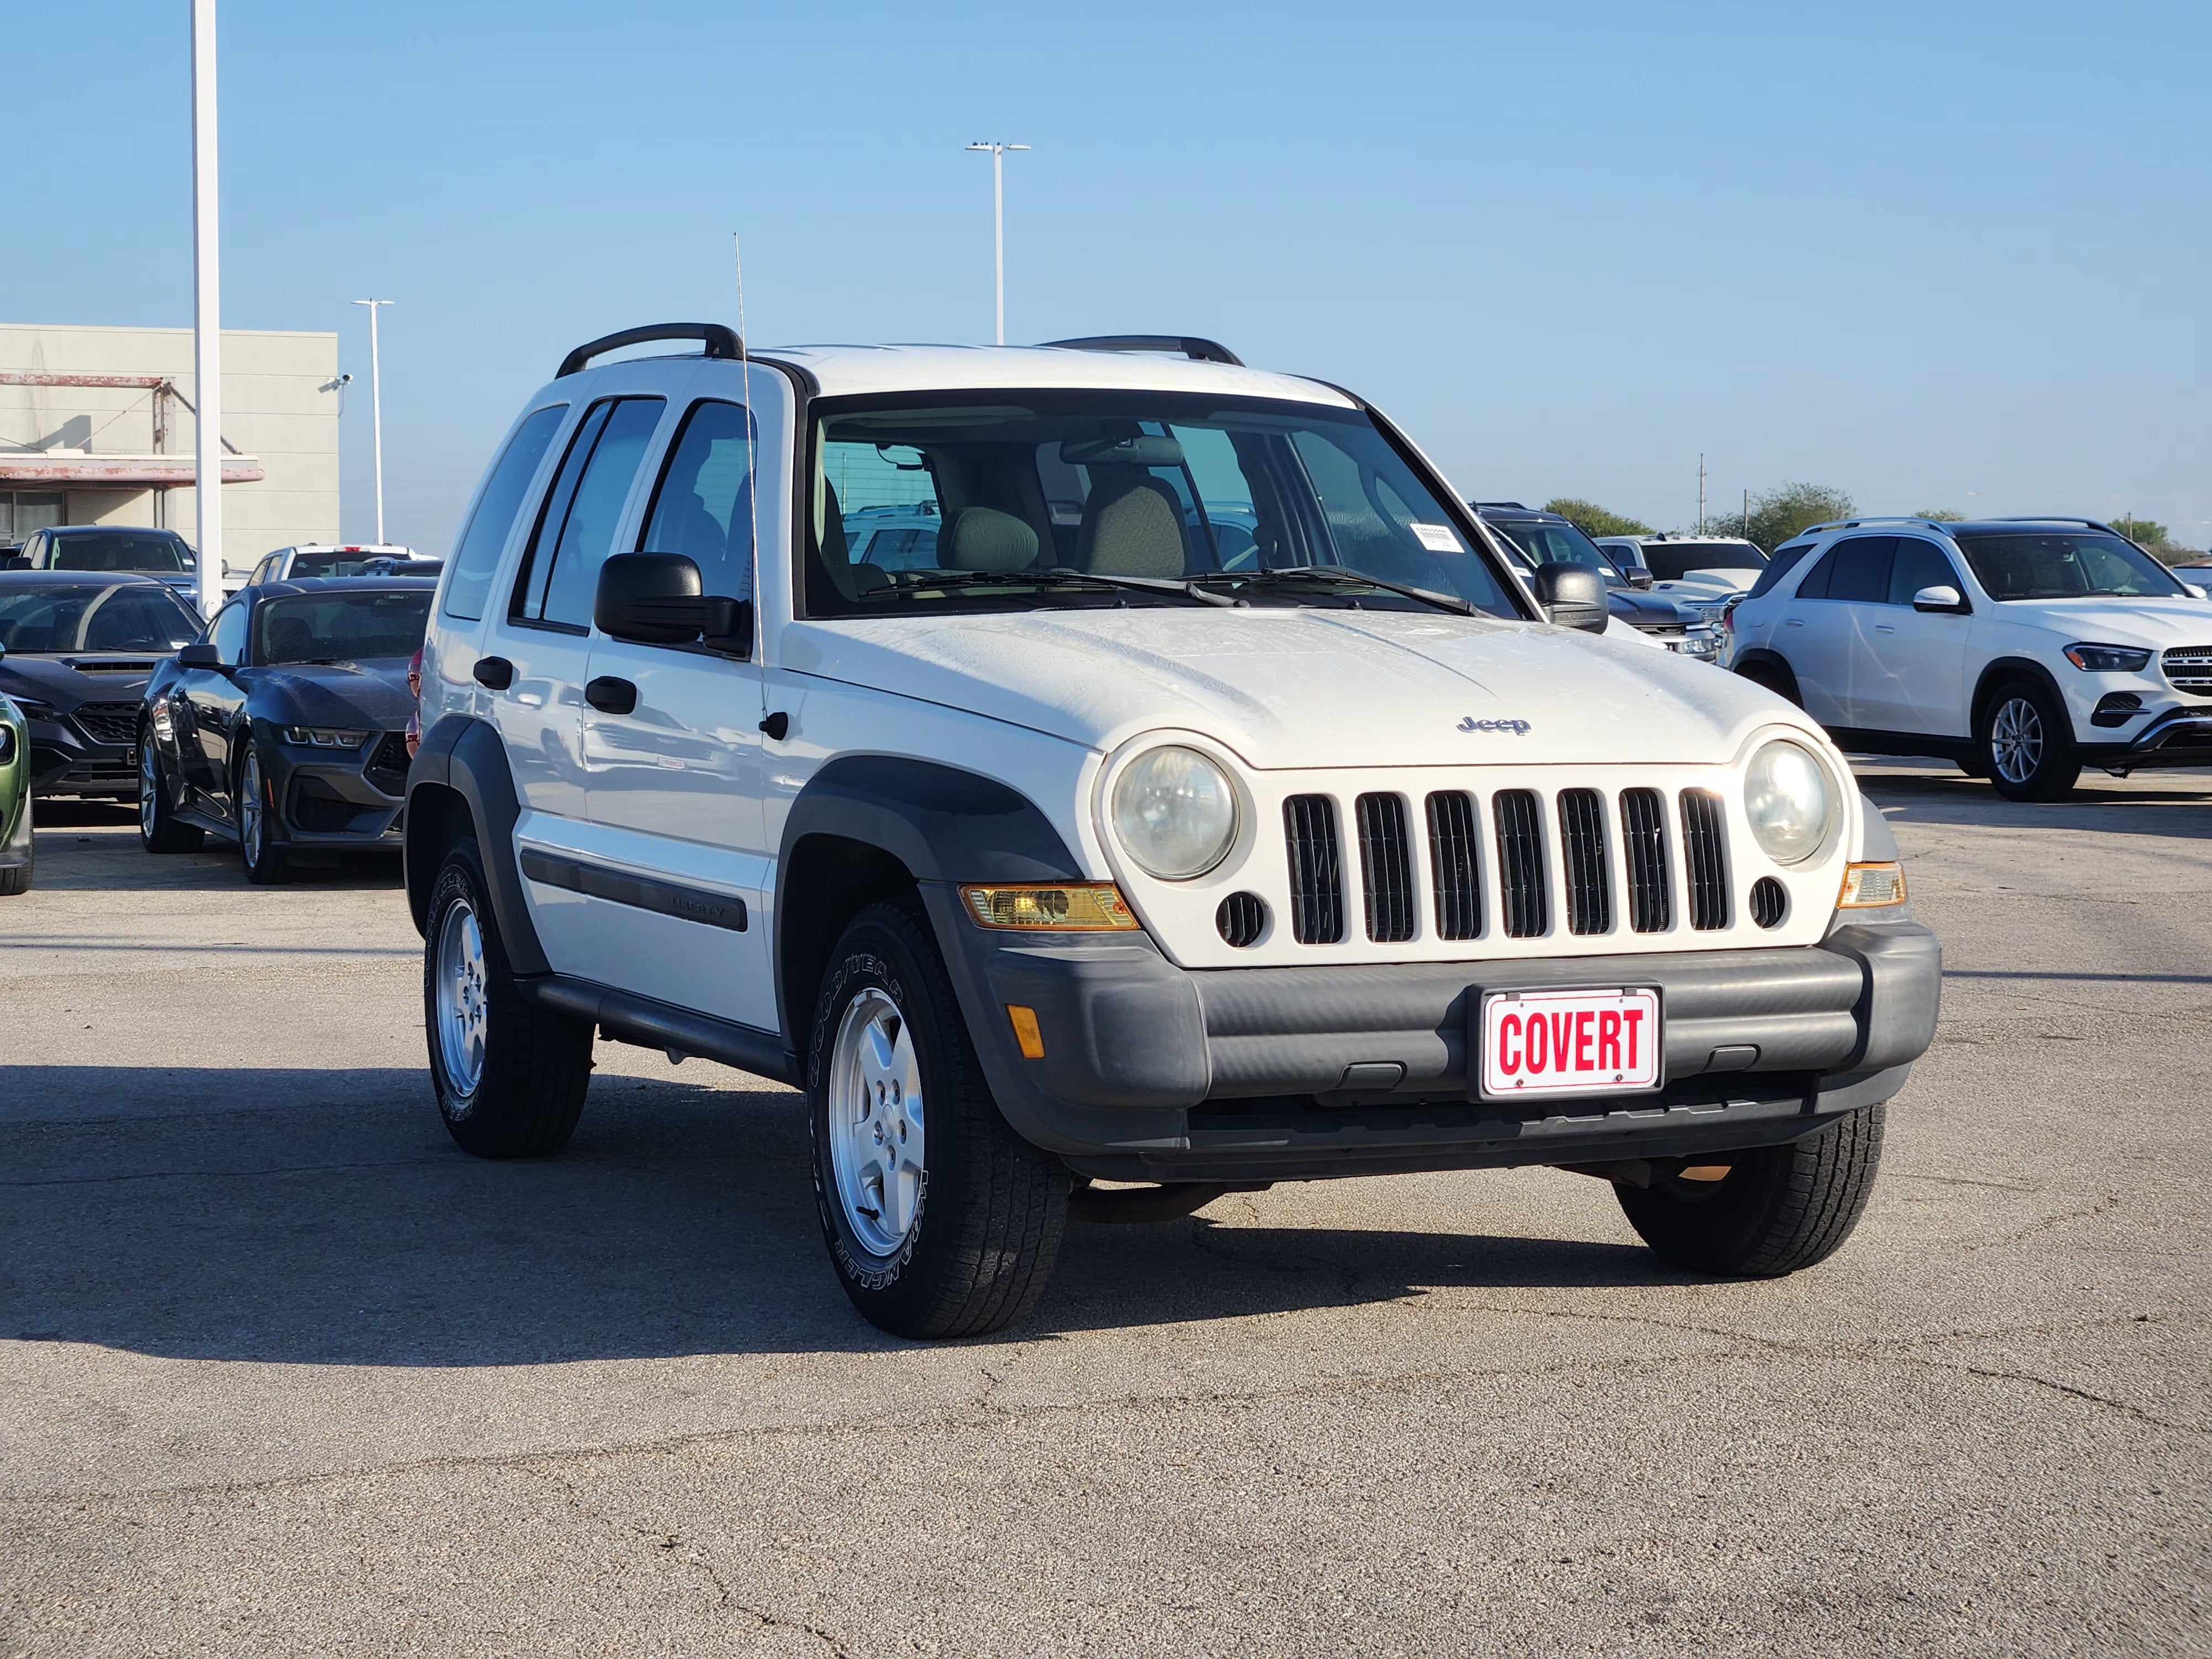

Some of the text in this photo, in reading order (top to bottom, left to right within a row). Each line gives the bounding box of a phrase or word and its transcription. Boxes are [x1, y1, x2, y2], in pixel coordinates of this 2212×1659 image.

[1455, 716, 1532, 736] Jeep
[811, 953, 904, 1088] GOODYEAR
[1499, 1009, 1643, 1076] COVERT
[834, 1170, 929, 1290] WRANGLER
